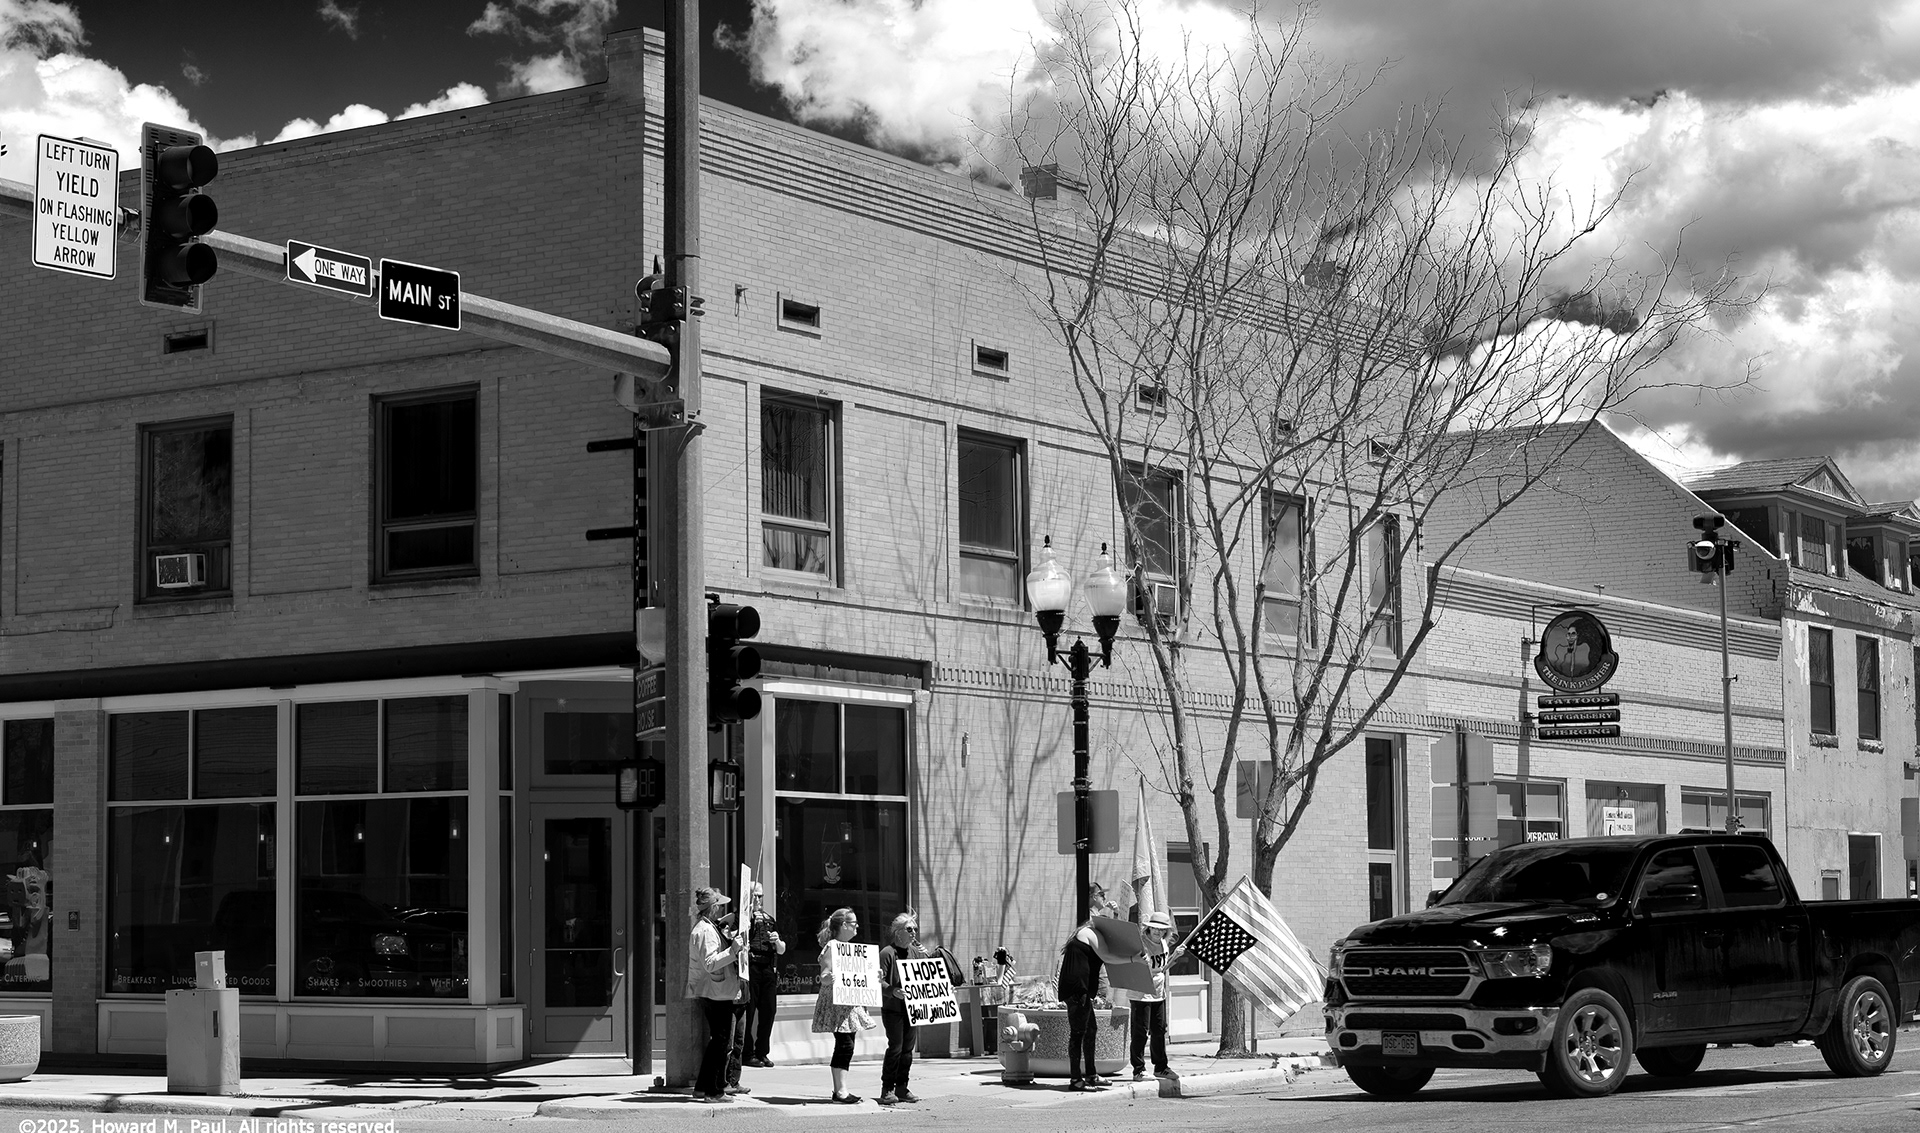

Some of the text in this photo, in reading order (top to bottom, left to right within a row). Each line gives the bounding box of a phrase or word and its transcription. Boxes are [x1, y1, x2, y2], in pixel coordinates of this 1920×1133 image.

[46, 143, 110, 171] LEFT TURN
[56, 171, 99, 198] YIELD
[40, 198, 113, 227] ON FLASHING
[52, 222, 99, 246] YELLOW
[54, 245, 96, 268] ARROW
[315, 259, 365, 283] ONE WAY
[389, 279, 452, 310] MAIN ST
[1542, 661, 1611, 689] THE INK PUSHER
[637, 674, 657, 699] COFFEE
[1546, 697, 1611, 705] TATTOOS
[1565, 712, 1612, 720] GALLERY
[1546, 728, 1611, 736] PIERCING
[836, 943, 867, 958] YOU ARE
[1151, 952, 1168, 969] 197
[118, 974, 157, 985] BREAKFAST
[241, 975, 271, 986] GOODS
[842, 973, 868, 988] to feel
[901, 960, 947, 981] I HOPE
[1374, 967, 1426, 976] RAM
[307, 976, 340, 987] SHAKES
[358, 977, 408, 988] SMOOTHIES
[904, 981, 949, 1001] SOMEDAY
[929, 1003, 945, 1023] join
